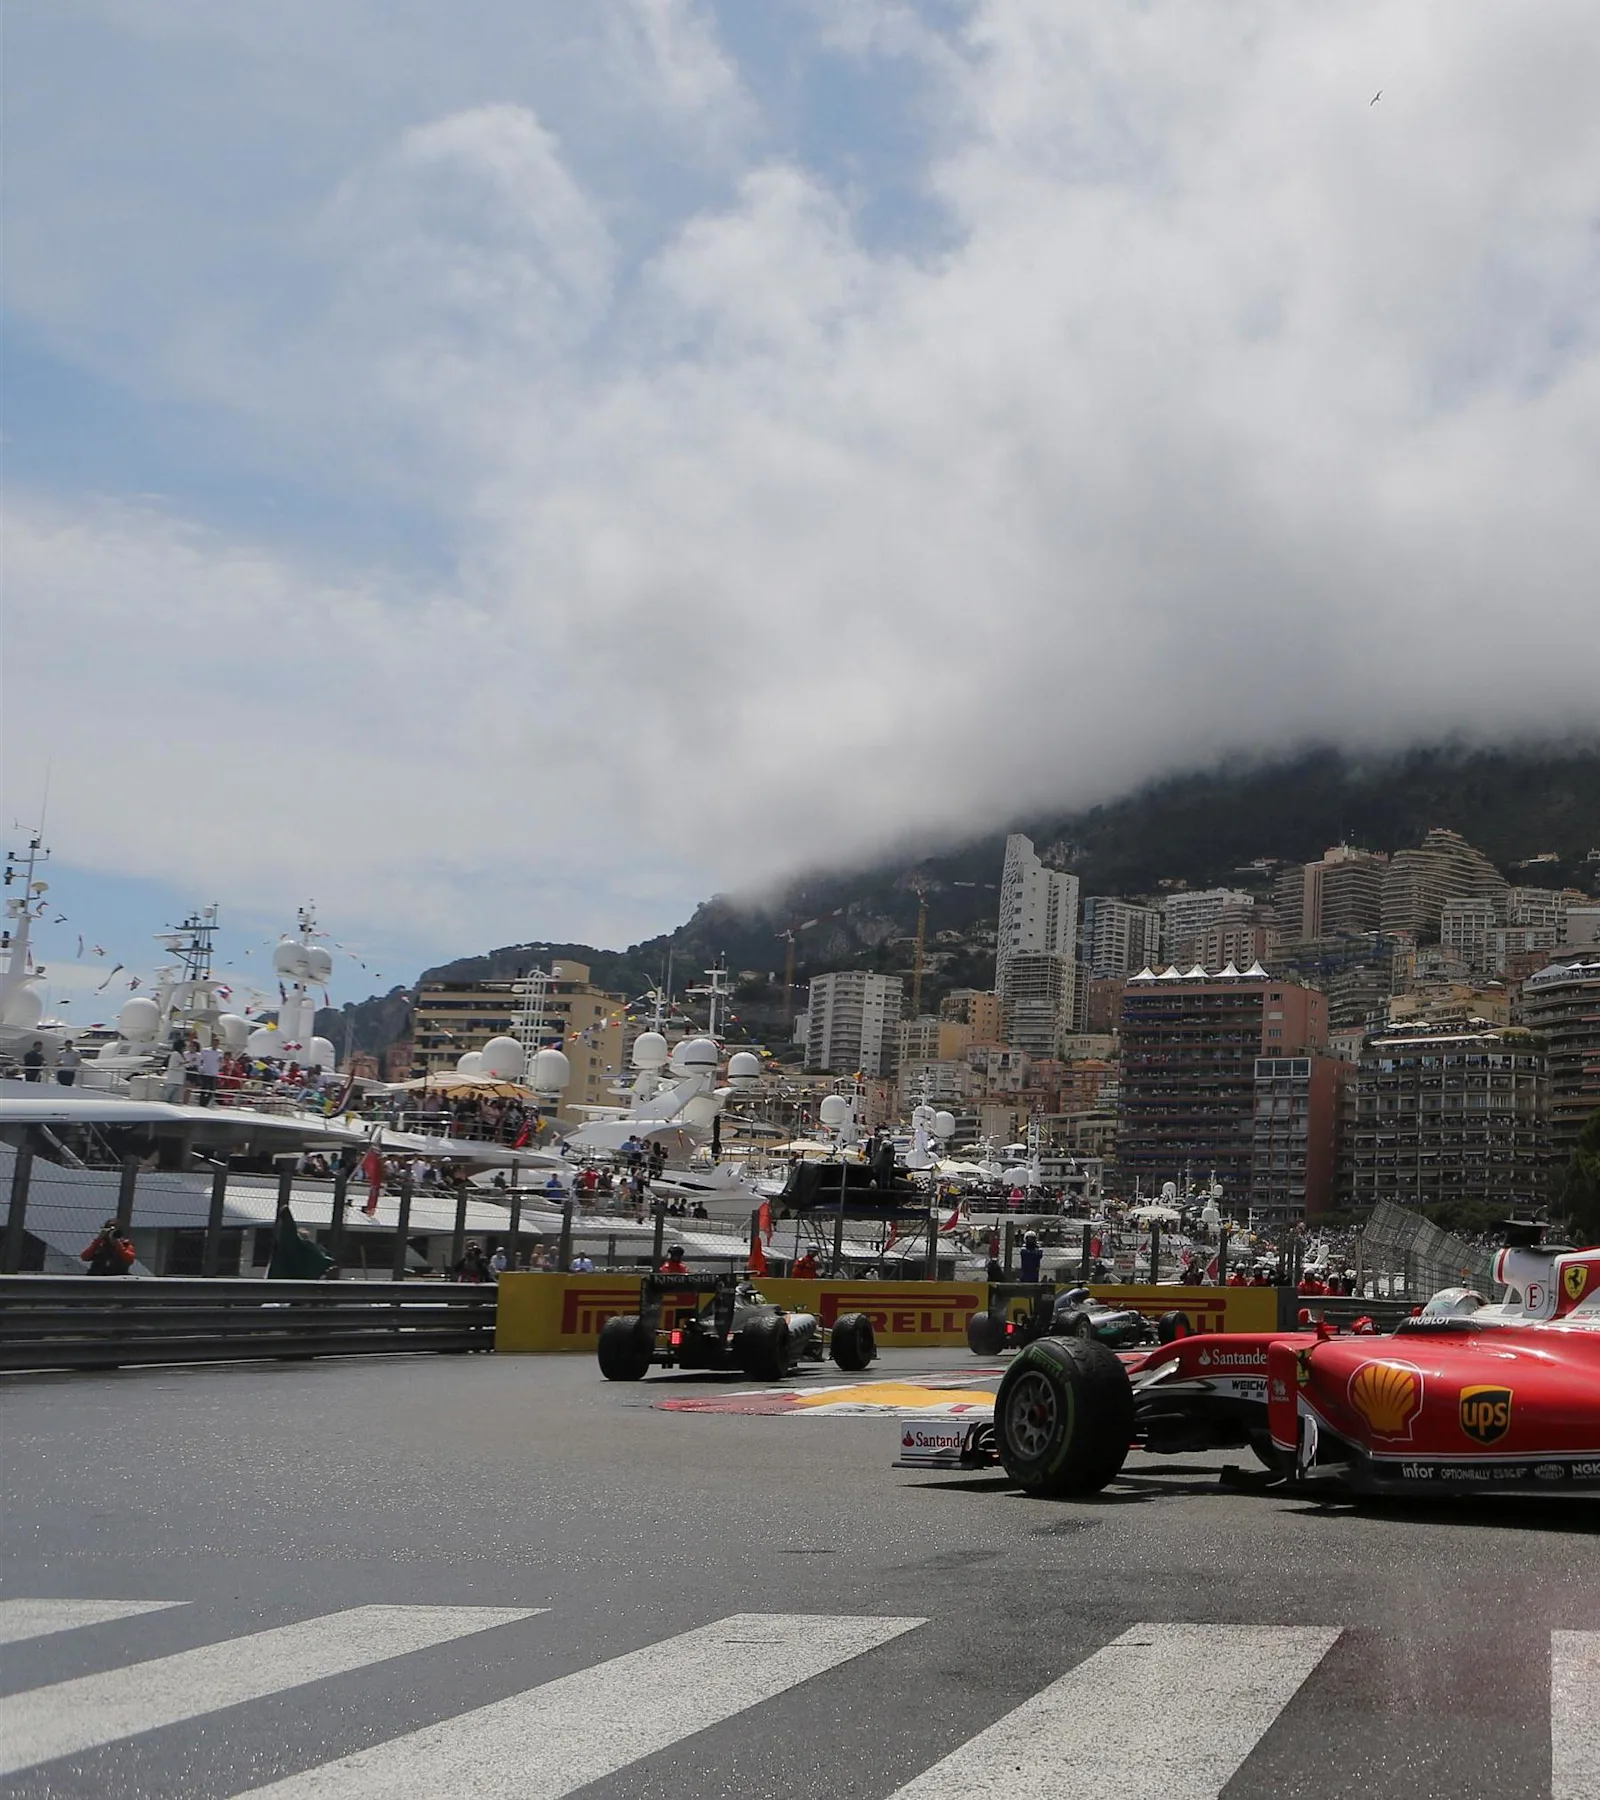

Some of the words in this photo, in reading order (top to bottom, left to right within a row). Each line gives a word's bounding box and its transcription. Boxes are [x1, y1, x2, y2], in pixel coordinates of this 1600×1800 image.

[1528, 1286, 1538, 1308] E
[1409, 1316, 1451, 1325] HUBLOT
[1212, 1347, 1268, 1365] Santande
[1463, 1402, 1507, 1436] ups
[1402, 1463, 1434, 1478] infor
